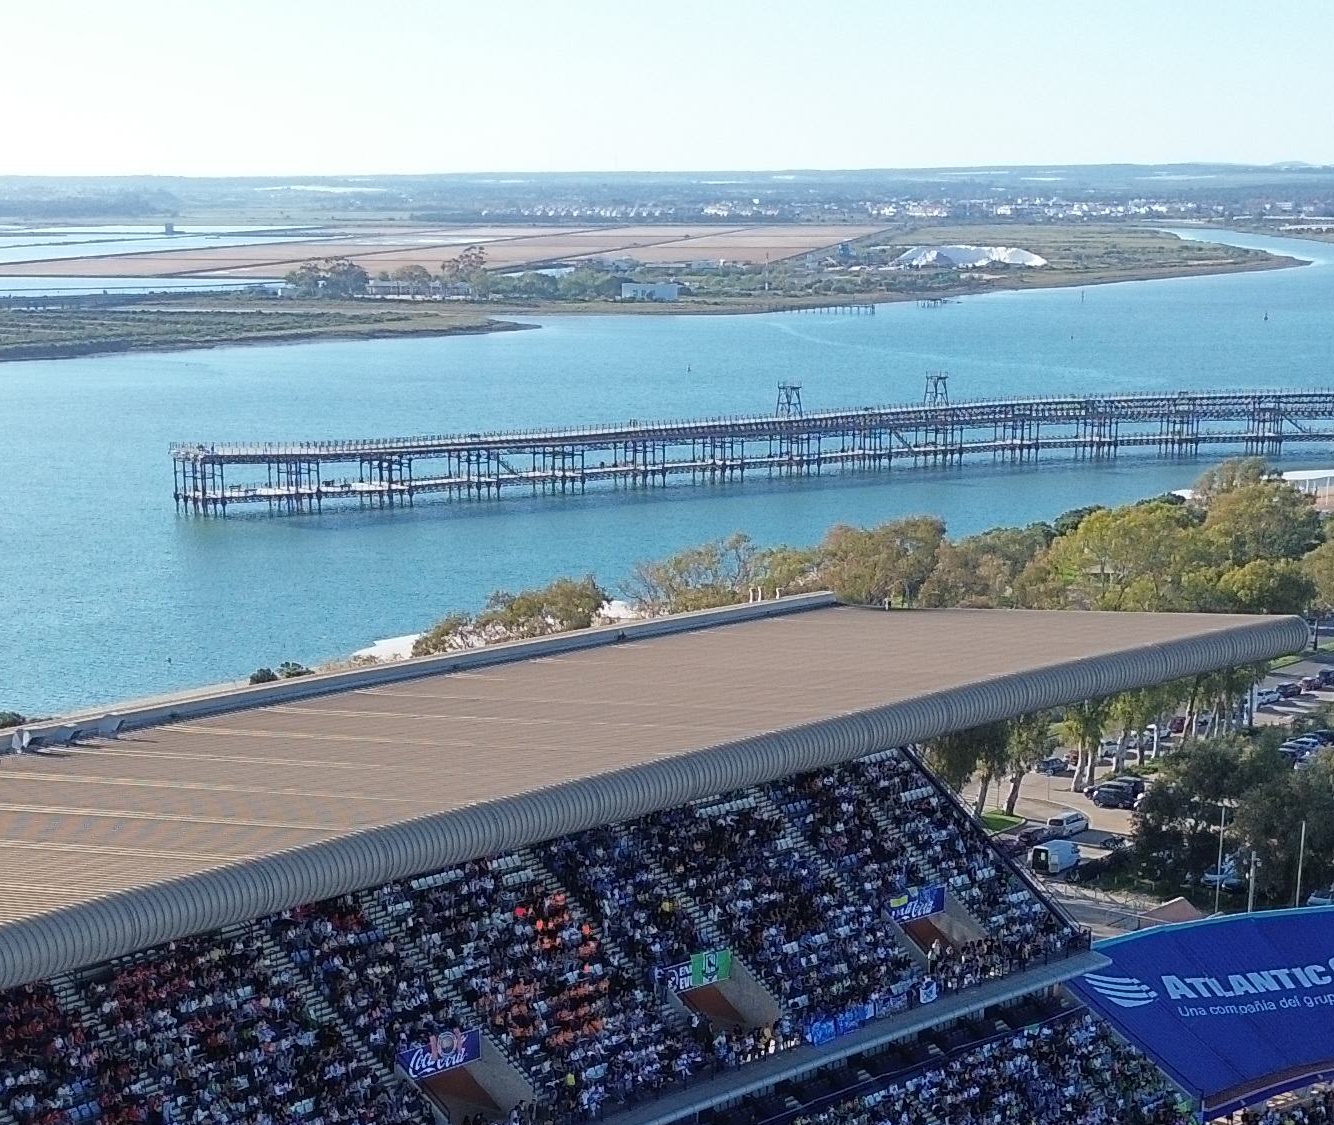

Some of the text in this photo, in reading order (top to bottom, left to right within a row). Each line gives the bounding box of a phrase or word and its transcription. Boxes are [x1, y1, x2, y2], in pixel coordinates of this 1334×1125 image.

[1160, 963, 1332, 1000] ATLANTIC
[1177, 1005, 1207, 1017] Una
[1279, 995, 1301, 1009] del
